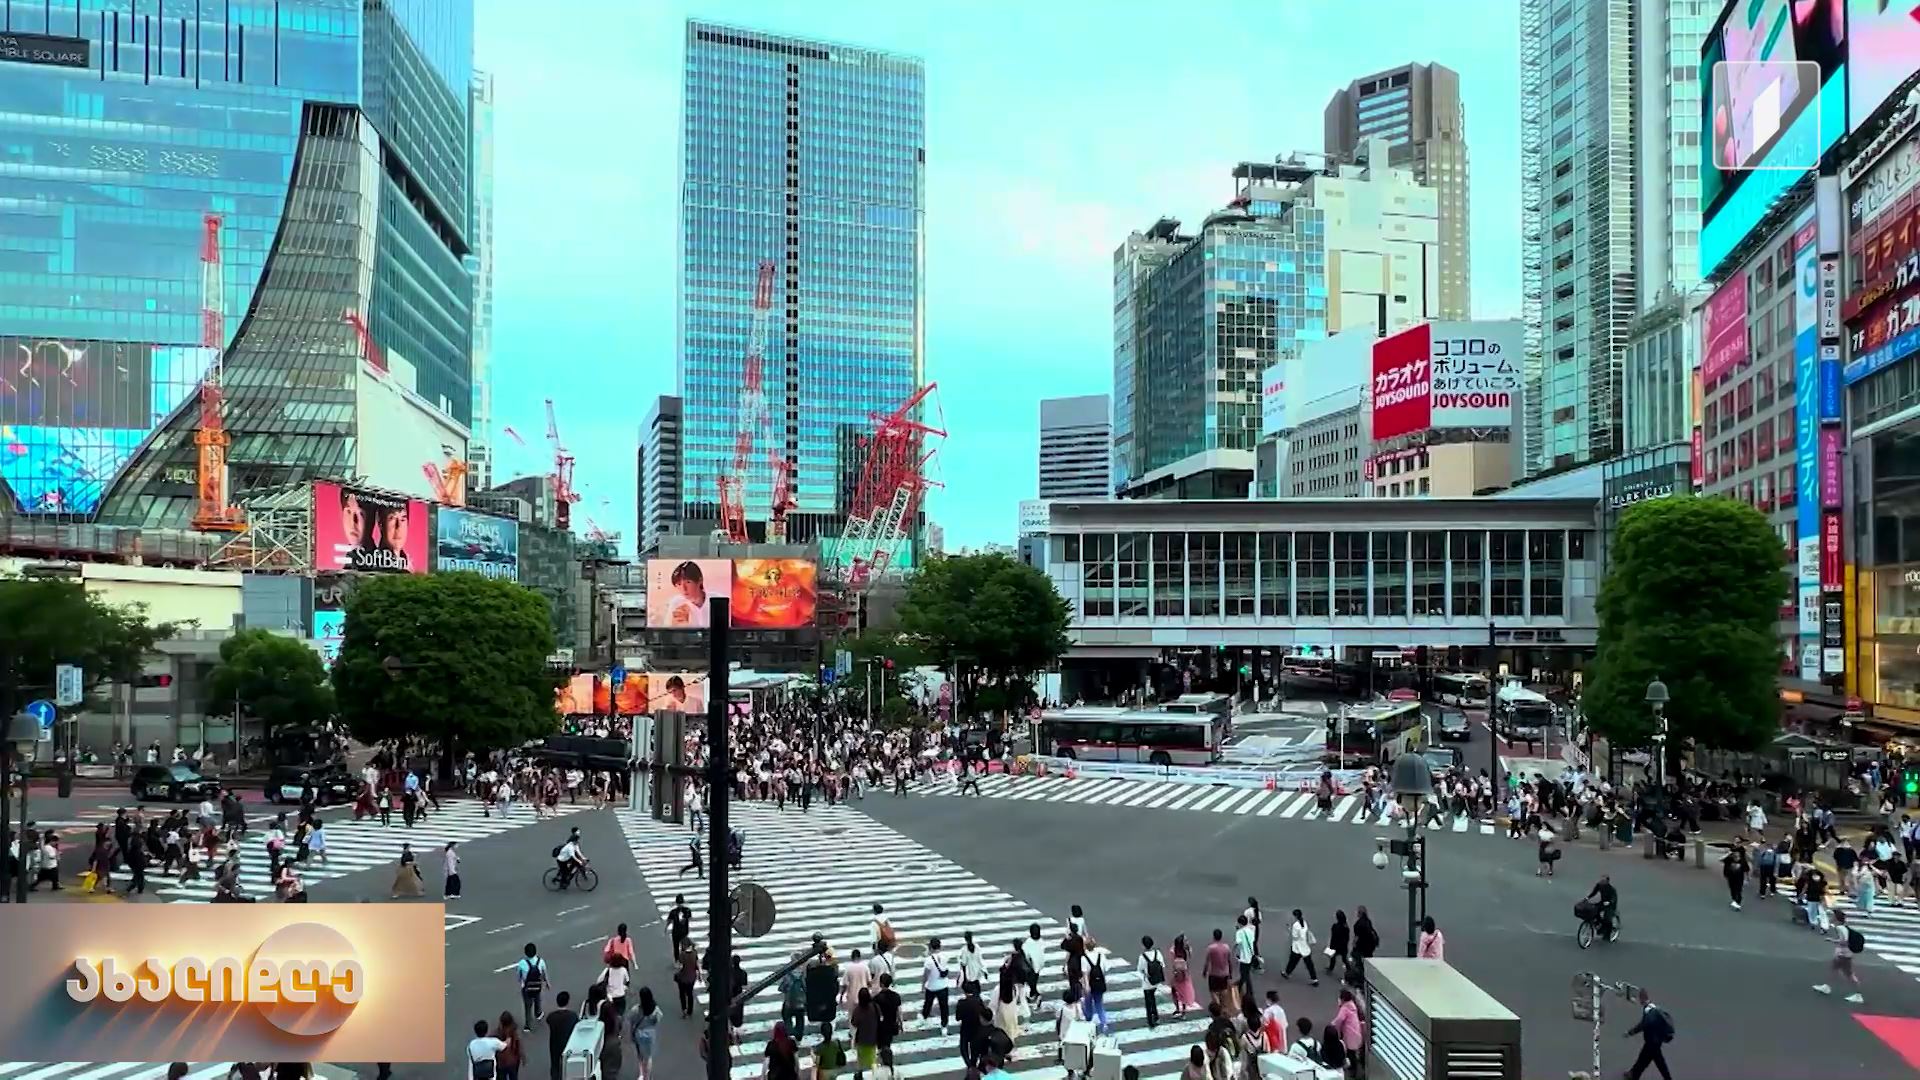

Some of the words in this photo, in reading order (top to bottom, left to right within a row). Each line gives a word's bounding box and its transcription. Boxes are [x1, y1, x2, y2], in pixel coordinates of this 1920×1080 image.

[32, 49, 85, 64] SQUARE
[1433, 339, 1501, 356] ココロの
[1852, 329, 1865, 352] 7F
[1433, 357, 1520, 374] ボリューム、
[1375, 358, 1428, 394] カラオケ
[1433, 377, 1522, 390] あげていこう。
[1375, 381, 1429, 410] JOYSOUND
[1609, 491, 1641, 505] MARK
[1644, 484, 1674, 499] CITY
[355, 547, 413, 571] SoftBank
[322, 586, 344, 606] JR
